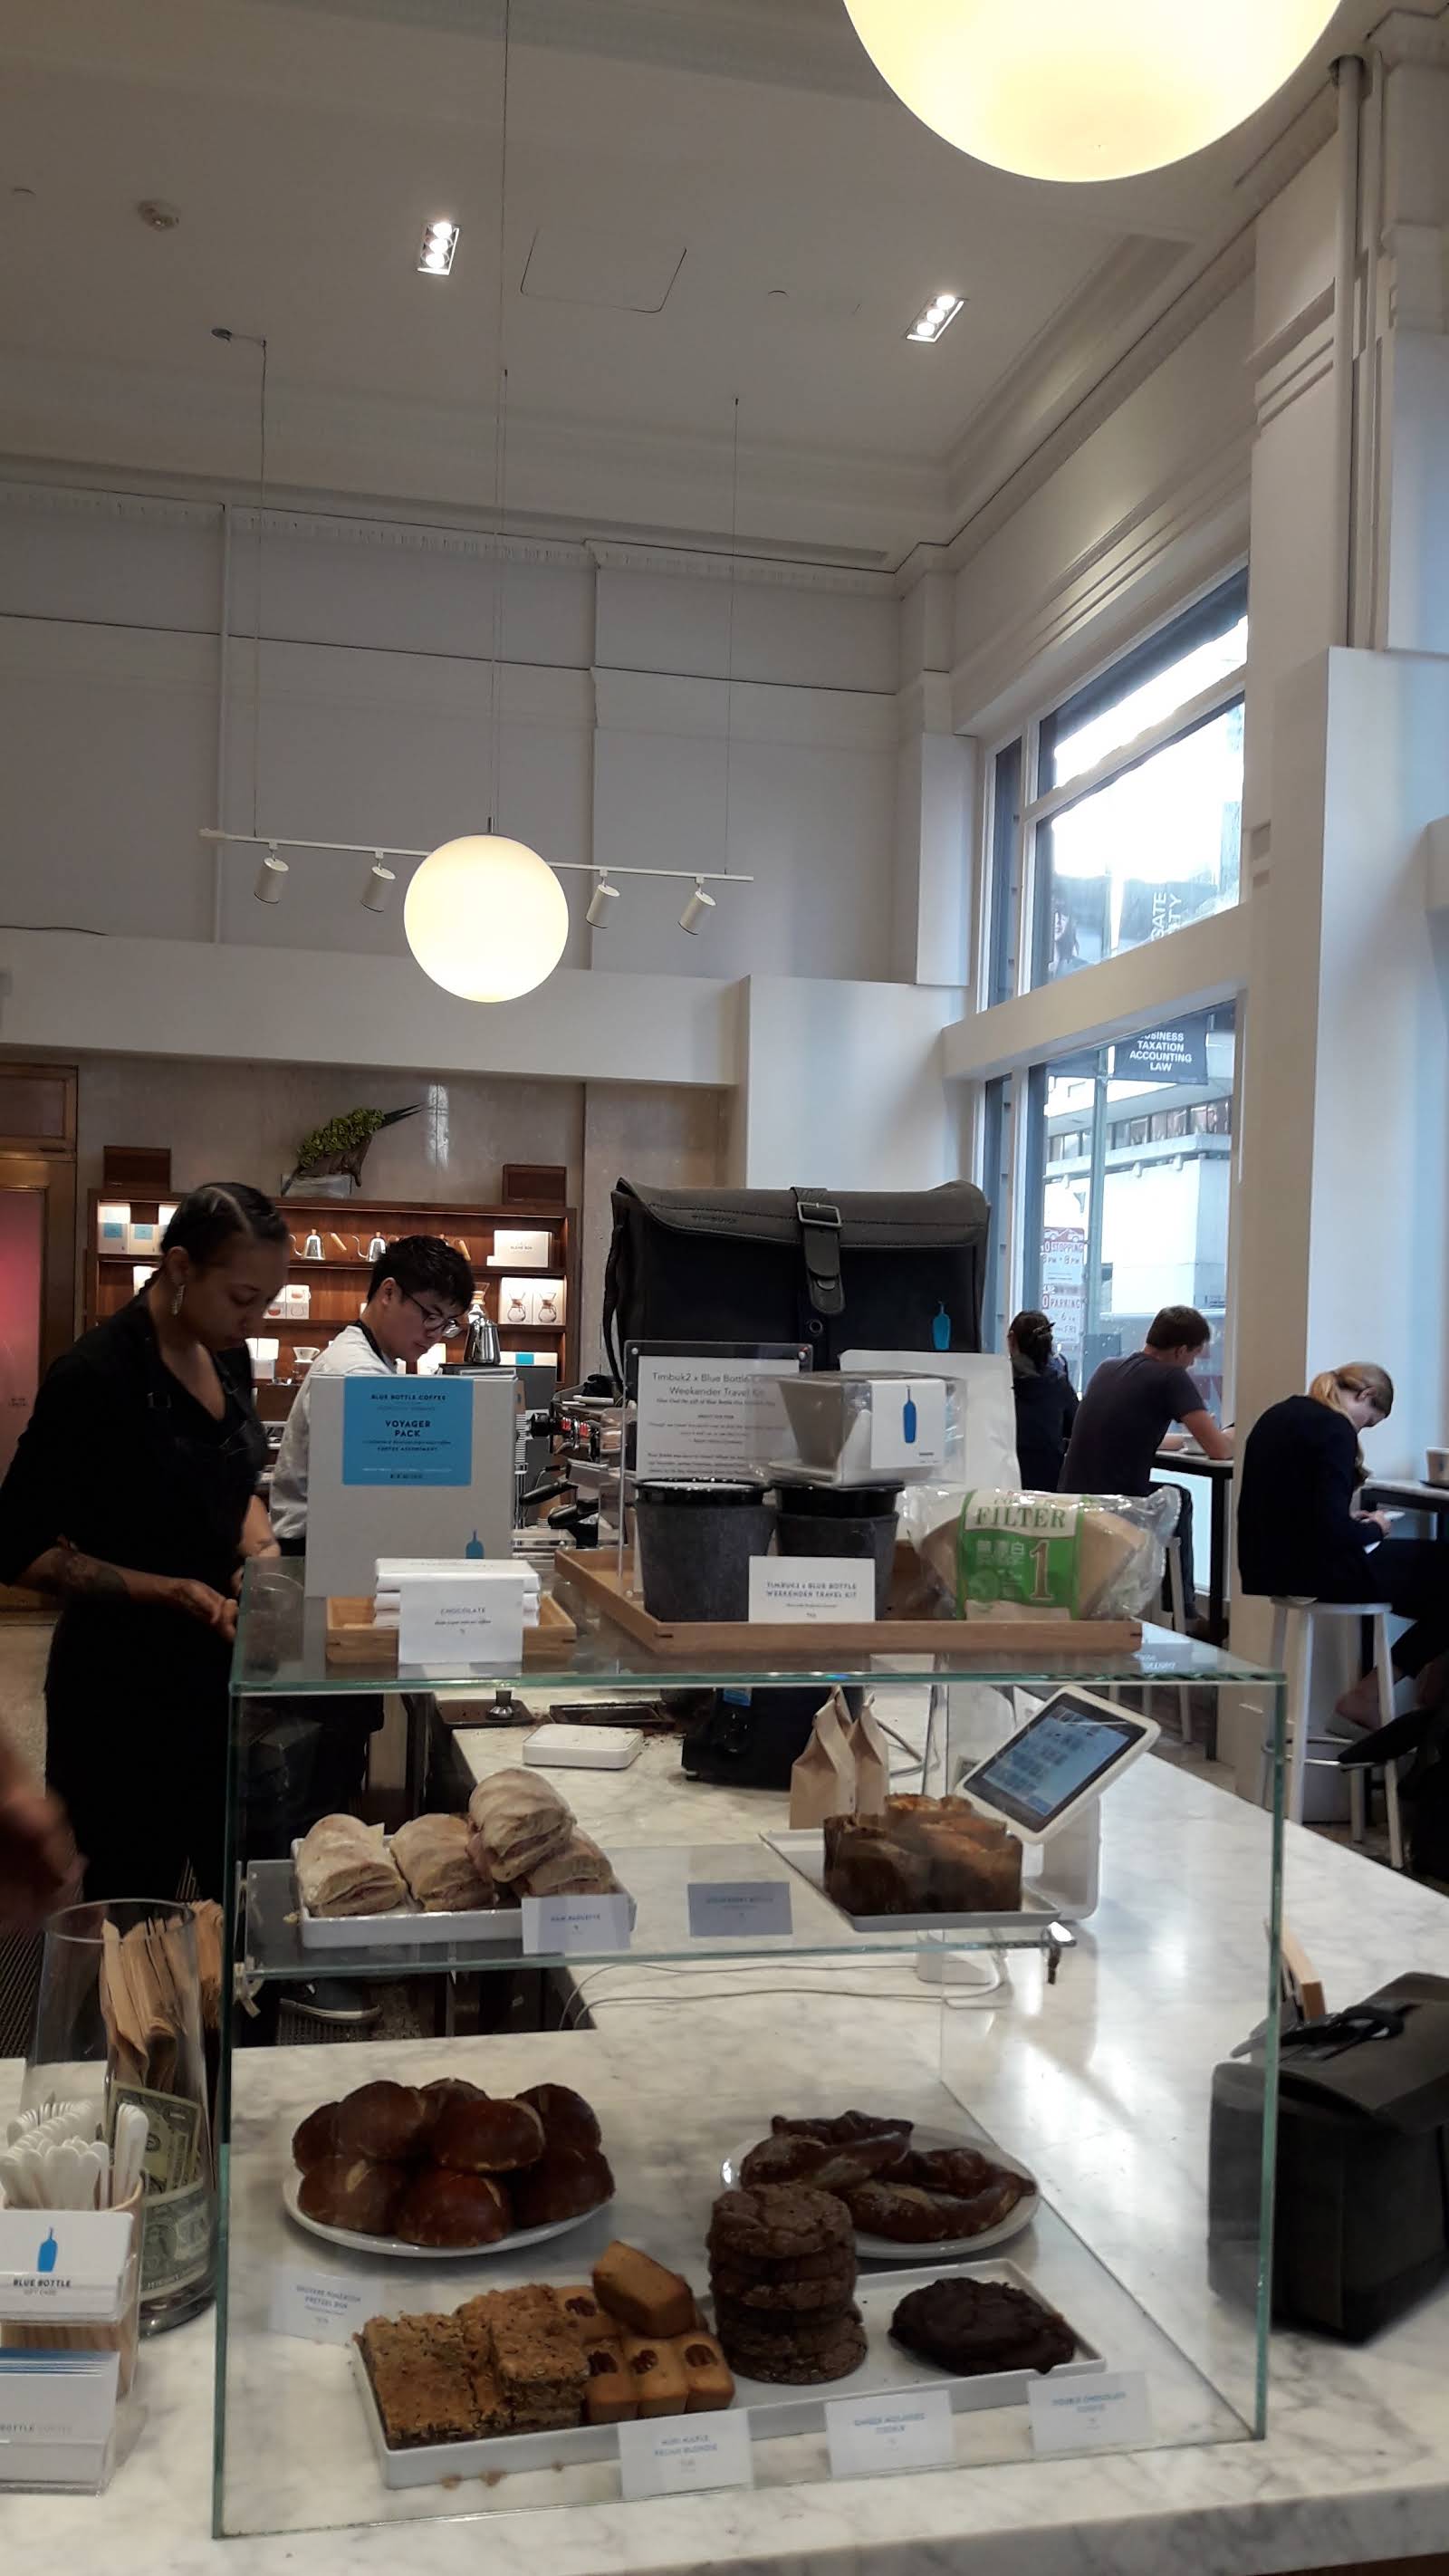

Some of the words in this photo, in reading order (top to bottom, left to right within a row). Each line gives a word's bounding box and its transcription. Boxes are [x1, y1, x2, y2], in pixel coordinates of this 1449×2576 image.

[1137, 1040, 1185, 1052] TAXATION
[1129, 1051, 1192, 1063] ACCOUNTING
[1150, 1062, 1172, 1072] LAW
[652, 1371, 691, 1381] Timbuk2
[701, 1373, 721, 1383] Blue
[669, 1386, 721, 1396] Weekender
[385, 1419, 431, 1427] VOYAGER
[395, 1429, 421, 1437] PACK
[975, 1506, 1066, 1528] FILTER
[1029, 1538, 1054, 1600] 1
[440, 1607, 486, 1615] CHOCOLATE
[14, 2279, 35, 2287] BLUE
[37, 2279, 72, 2288] BOTTLE
